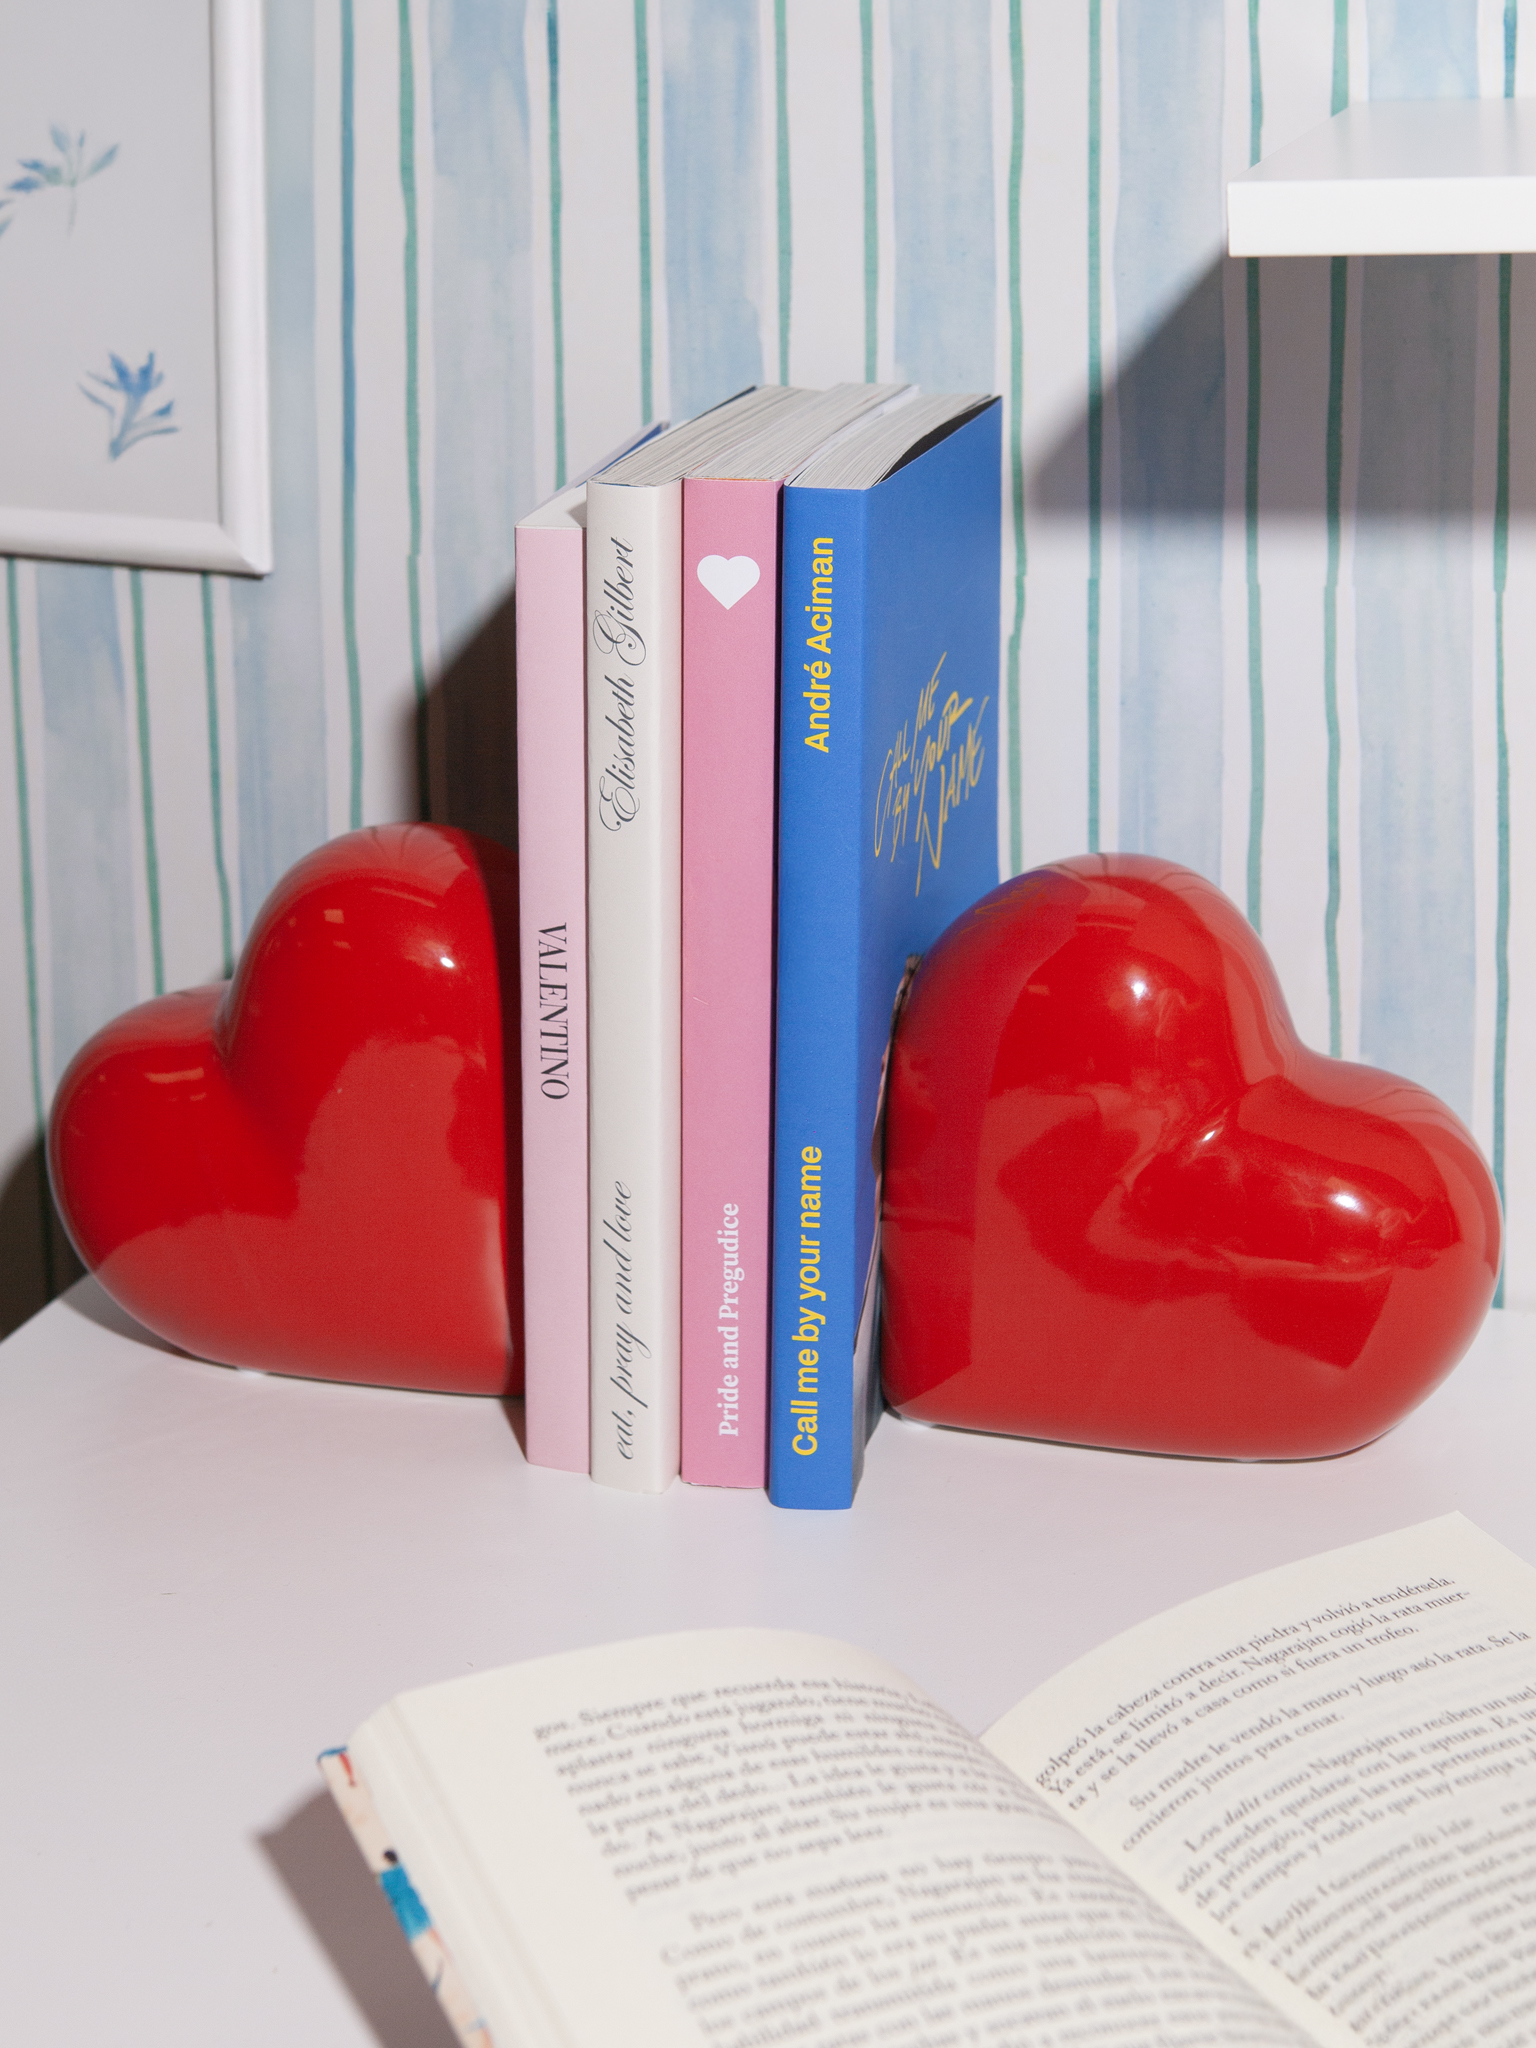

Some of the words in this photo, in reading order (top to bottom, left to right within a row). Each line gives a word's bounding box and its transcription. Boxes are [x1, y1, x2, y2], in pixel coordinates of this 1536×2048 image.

[593, 537, 646, 666] Gilbert
[805, 537, 833, 654] Aciman
[803, 661, 832, 753] André
[599, 673, 640, 831] Elisabeth
[538, 922, 570, 1100] VALENTINO
[603, 1180, 632, 1242] love
[800, 1146, 822, 1228] name
[603, 1238, 633, 1314] and
[717, 1203, 744, 1320] Pregudice
[800, 1234, 826, 1301] your
[610, 1323, 652, 1409] pray
[717, 1326, 739, 1369] and
[791, 1307, 826, 1342] by
[717, 1374, 739, 1436] Pride
[798, 1349, 819, 1393] me
[611, 1408, 636, 1460] eat,
[791, 1400, 819, 1456] Call
[1036, 1735, 1088, 1788] golpeó
[1085, 1724, 1106, 1739] la
[1106, 1687, 1162, 1727] cabeza
[1162, 1659, 1216, 1691] contra
[1215, 1644, 1249, 1664] una
[1248, 1625, 1301, 1653] piedra
[1299, 1619, 1313, 1633] y
[1312, 1601, 1361, 1624] volvió
[1361, 1600, 1374, 1610] a
[1372, 1577, 1456, 1606] tendérsela.
[1049, 1776, 1074, 1796] Ya
[1074, 1747, 1114, 1777] está,
[1112, 1730, 1132, 1747] se
[1129, 1694, 1184, 1733] limitó
[1185, 1690, 1197, 1701] a
[1199, 1669, 1246, 1694] decir.
[1241, 1633, 1328, 1671] Nagarajan
[1330, 1618, 1374, 1640] cogió
[1371, 1612, 1391, 1626] la
[1392, 1603, 1425, 1620] rata
[1425, 1590, 1471, 1610] muer-
[1068, 1794, 1087, 1811] ta
[1087, 1781, 1100, 1799] y
[1100, 1765, 1120, 1783] se
[1116, 1751, 1138, 1767] la
[1135, 1723, 1179, 1754] llevó
[1181, 1714, 1193, 1727] a
[1194, 1695, 1231, 1718] casa
[1232, 1673, 1279, 1698] como
[1280, 1664, 1296, 1678] si
[1295, 1648, 1342, 1671] fuera
[1341, 1640, 1366, 1655] un
[1365, 1625, 1420, 1647] trofeo.
[1129, 1789, 1157, 1811] Su
[1158, 1753, 1212, 1792] madre
[1208, 1743, 1231, 1756] le
[1230, 1713, 1283, 1745] vendó
[1279, 1705, 1301, 1720] la
[1302, 1686, 1350, 1712] mano
[1350, 1681, 1364, 1696] y
[1359, 1665, 1409, 1688] luego
[1409, 1656, 1437, 1673] asó
[1433, 1651, 1455, 1665] la
[1455, 1641, 1492, 1659] rata.
[1487, 1633, 1514, 1649] Se
[1509, 1629, 1532, 1642] la
[1399, 1725, 1422, 1740] no
[1423, 1705, 1483, 1732] reciben
[1482, 1698, 1508, 1712] un
[1122, 1787, 1199, 1852] comieron
[1195, 1753, 1254, 1794] juntos
[1254, 1733, 1294, 1761] para
[1294, 1712, 1345, 1738] cenar.
